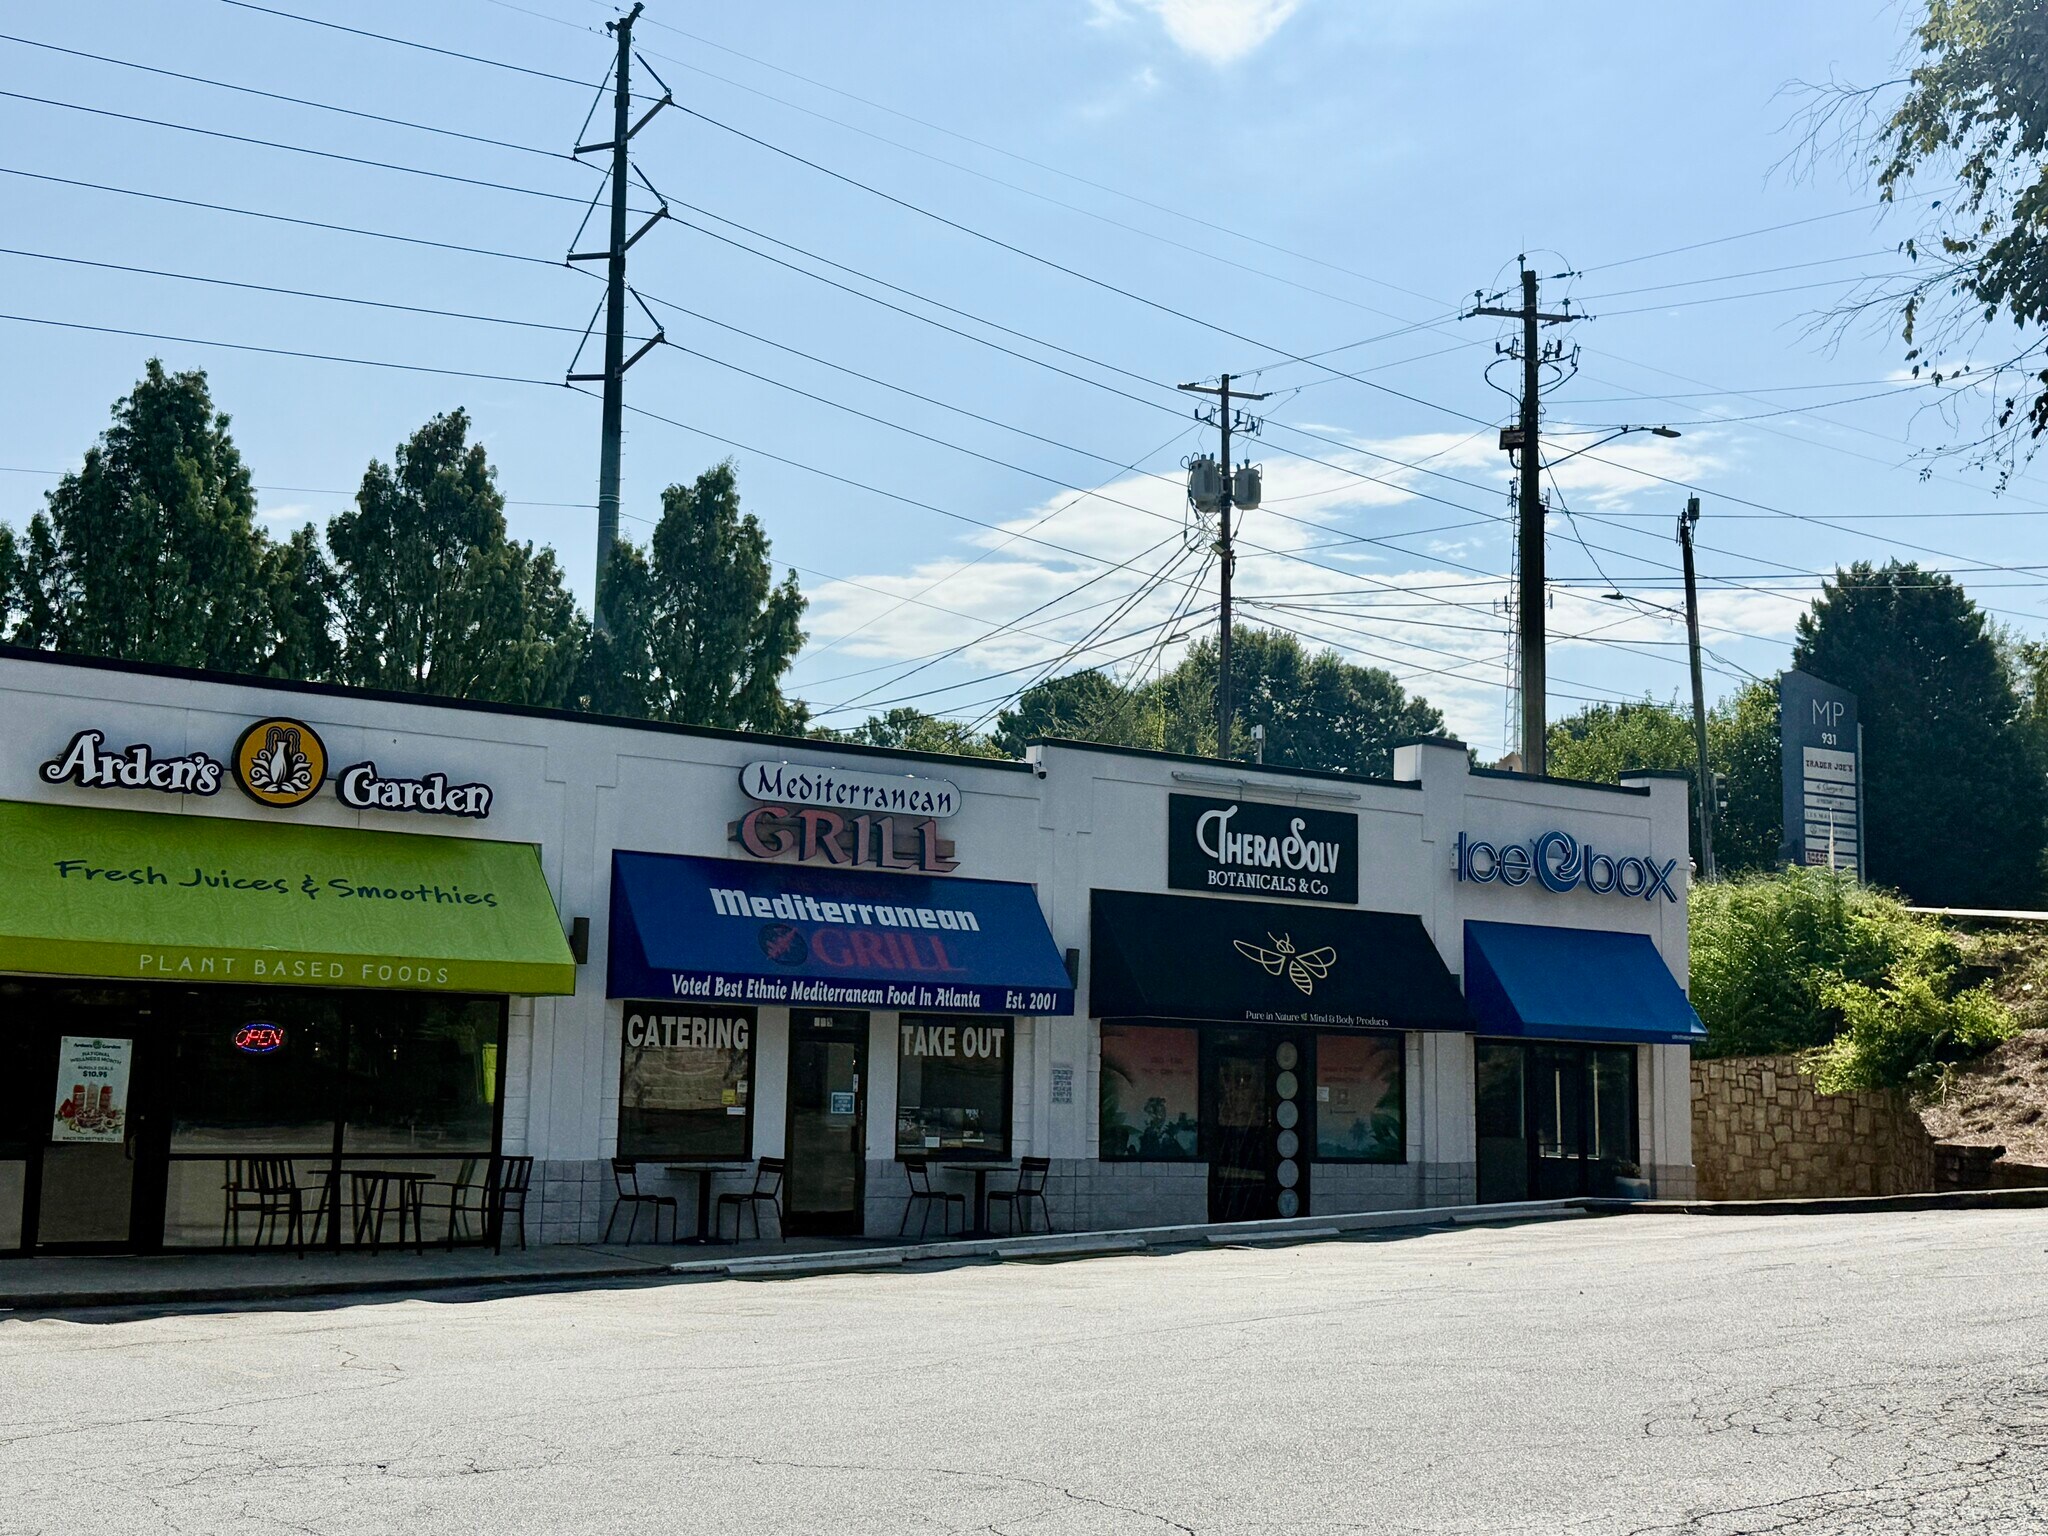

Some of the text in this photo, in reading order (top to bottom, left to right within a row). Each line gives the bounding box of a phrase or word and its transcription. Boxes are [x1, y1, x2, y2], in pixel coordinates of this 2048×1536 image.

[1812, 698, 1845, 727] MP
[1821, 732, 1837, 746] 931
[42, 729, 491, 816] Arden's Garden
[1805, 760, 1853, 773] TRADER JOE'S
[757, 764, 953, 813] Mediterranean
[739, 805, 961, 873] GRILL
[54, 859, 499, 908] Fresh Juices & Smoothies
[1207, 869, 1296, 893] BOTANICALS
[1298, 878, 1309, 893] &
[709, 886, 981, 931] Mediterranean
[811, 926, 966, 971] GRILL
[138, 953, 450, 984] PLANT BASED FOODS
[671, 973, 1057, 1011] Voted Best Ethnic Mediterranean Food In Atlanta Est. 2001
[627, 1013, 750, 1051] CATERING
[1245, 1009, 1265, 1020] Pure
[1275, 1011, 1300, 1022] Nature
[1309, 1012, 1328, 1023] Mind
[1328, 1014, 1336, 1023] &
[1336, 1014, 1355, 1026] Body
[1356, 1015, 1389, 1027] Products
[235, 1028, 284, 1047] OPEN
[901, 1025, 1004, 1059] TAKE OUT
[82, 1070, 108, 1078] $10.95
